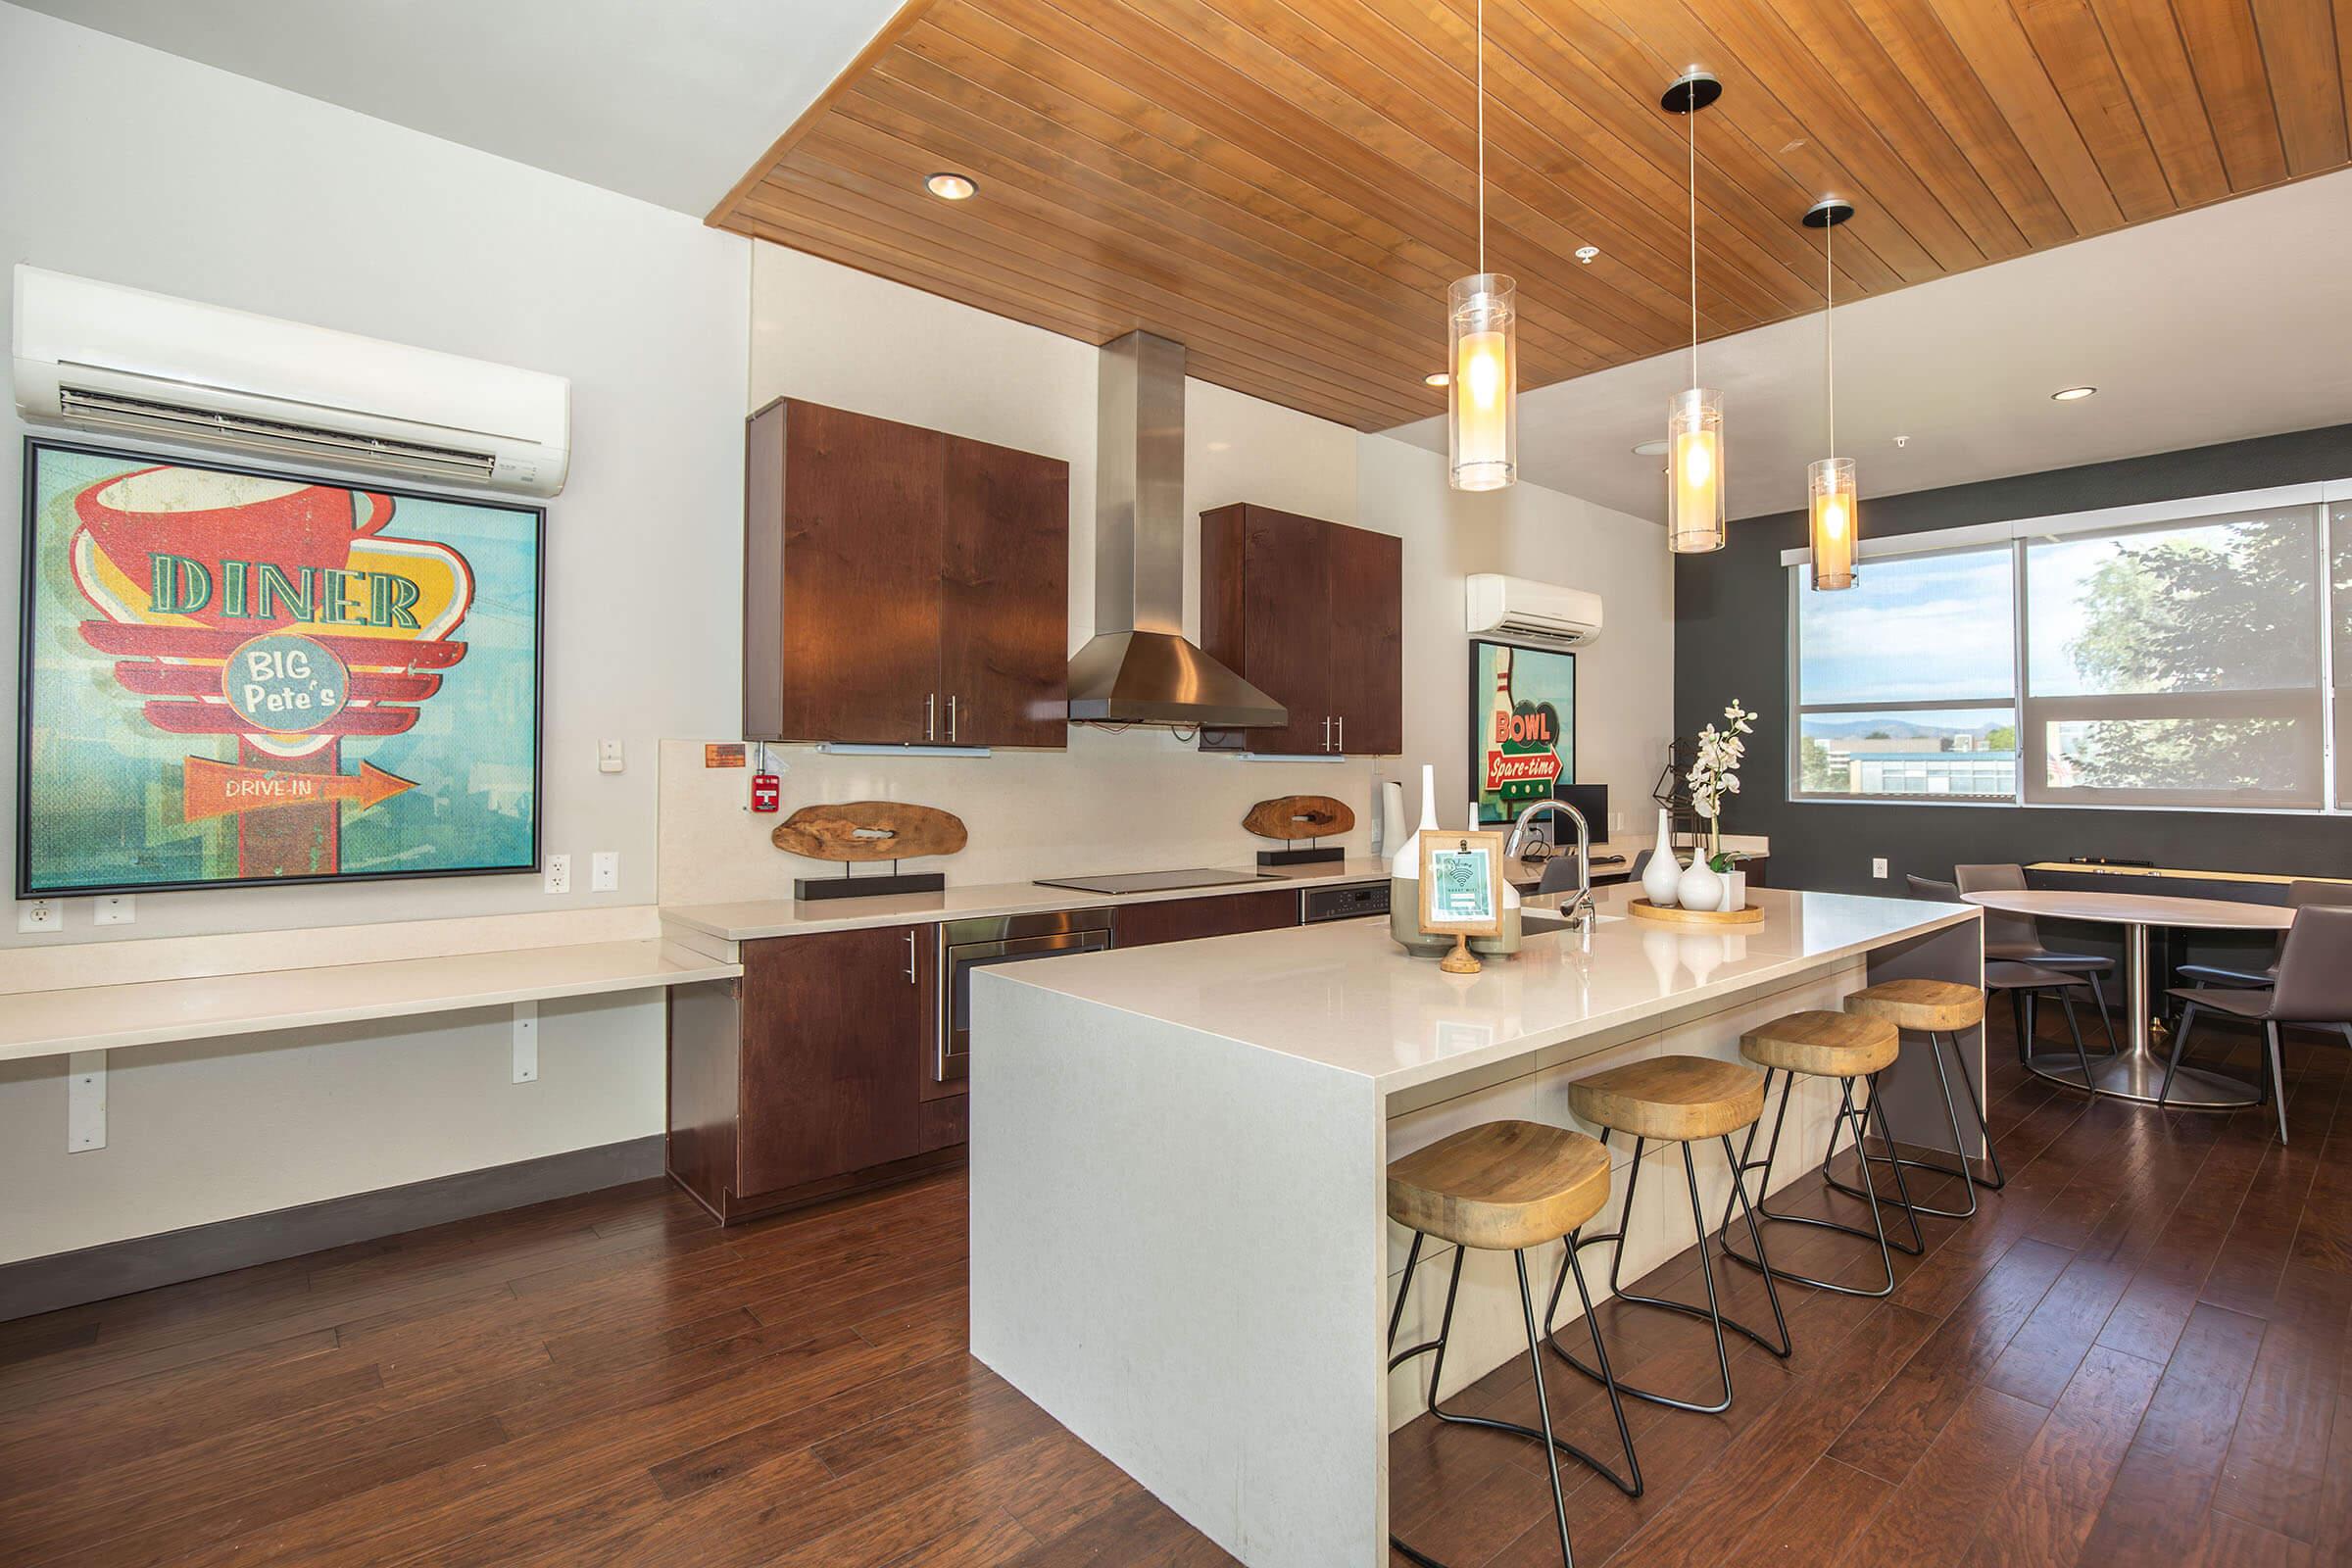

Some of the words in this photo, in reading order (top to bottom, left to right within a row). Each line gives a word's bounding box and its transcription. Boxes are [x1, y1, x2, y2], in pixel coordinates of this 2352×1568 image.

[148, 552, 421, 629] DINER
[247, 650, 312, 682] BIG
[244, 679, 337, 713] Pete's
[1495, 710, 1551, 743] BOWL
[1490, 757, 1555, 784] Spare-time
[225, 779, 313, 798] DRIVE-IN
